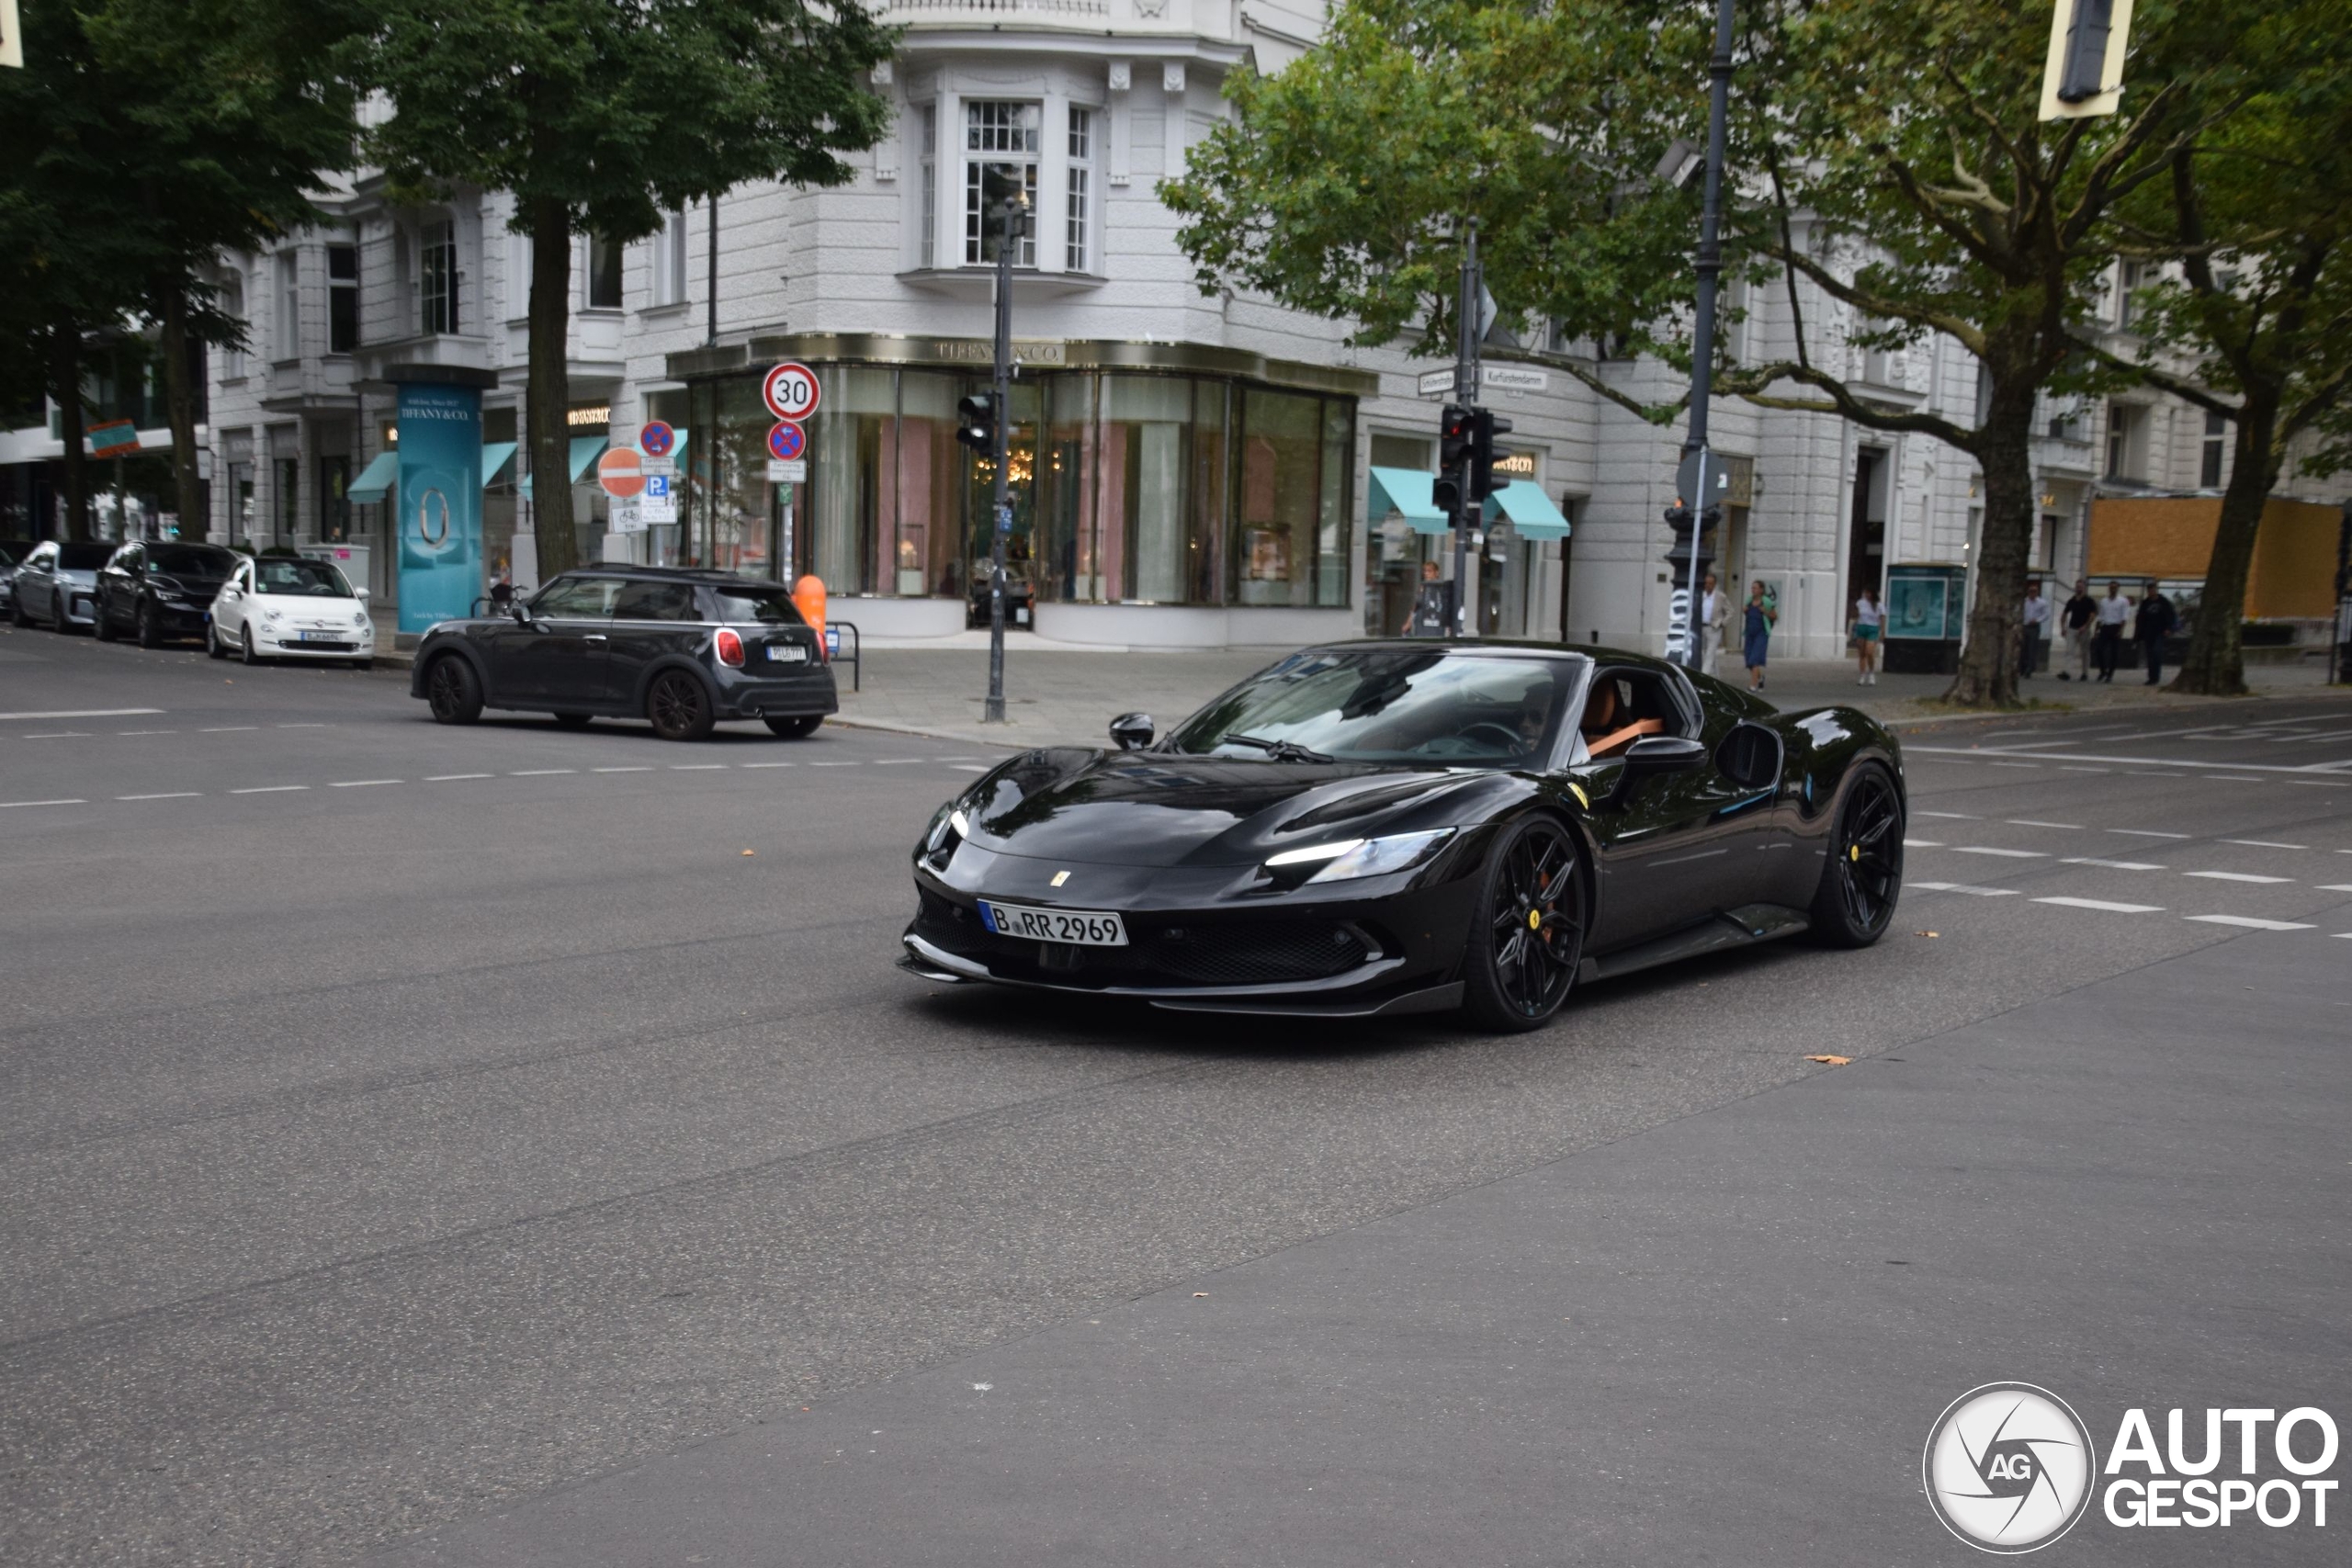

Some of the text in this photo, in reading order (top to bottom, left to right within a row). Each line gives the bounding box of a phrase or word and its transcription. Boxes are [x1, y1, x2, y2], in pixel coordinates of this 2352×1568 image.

[1487, 370, 1542, 385] Kurfürstendamm
[776, 379, 807, 405] 30
[650, 476, 663, 494] P
[992, 908, 1118, 942] B RR 2969
